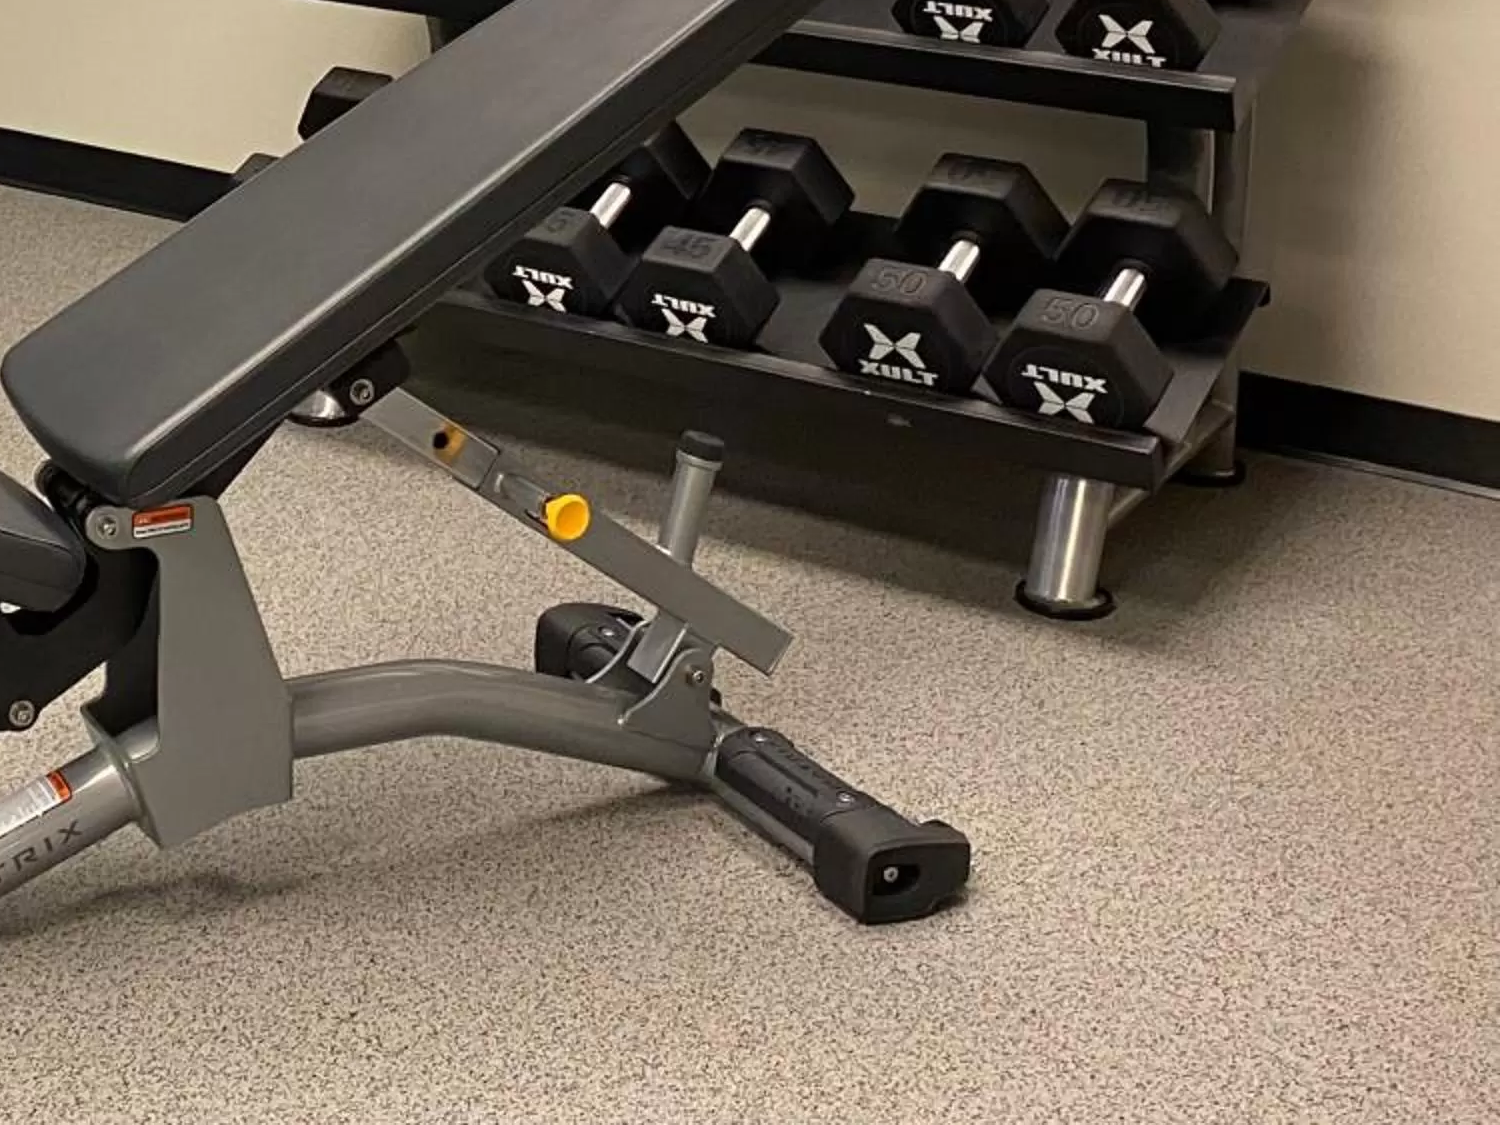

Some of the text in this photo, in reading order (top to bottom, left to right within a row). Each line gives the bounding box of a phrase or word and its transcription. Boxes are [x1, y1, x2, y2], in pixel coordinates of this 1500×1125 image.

[922, 0, 993, 23] XULT
[1092, 48, 1167, 69] XULT
[511, 264, 575, 291] XULT
[869, 266, 929, 296] 50
[650, 291, 717, 319] XULT
[1036, 295, 1101, 332] 50
[857, 358, 939, 388] XULT
[1020, 362, 1109, 395] XULT
